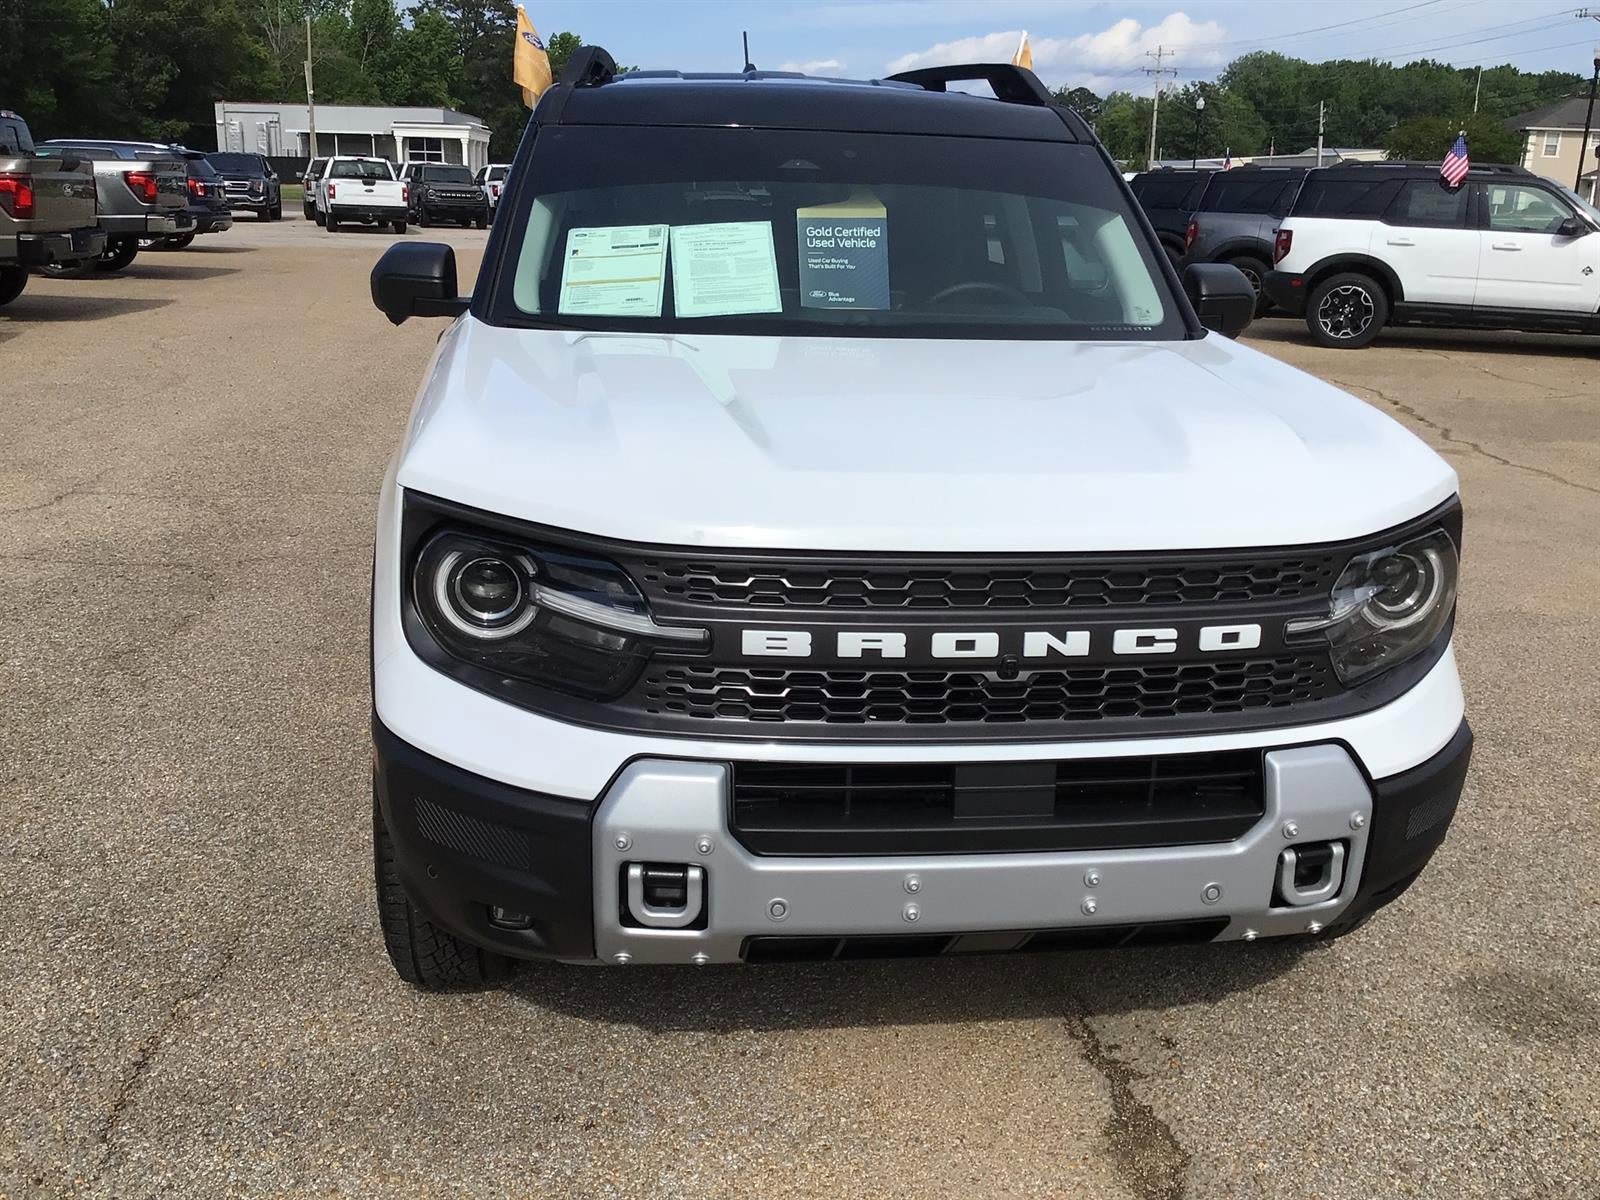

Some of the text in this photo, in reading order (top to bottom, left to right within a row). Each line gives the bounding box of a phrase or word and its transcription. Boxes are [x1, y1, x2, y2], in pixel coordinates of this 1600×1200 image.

[806, 227, 881, 237] Gold Certified
[807, 238, 876, 248] Used Vehicle
[741, 624, 1261, 658] BRONCO
